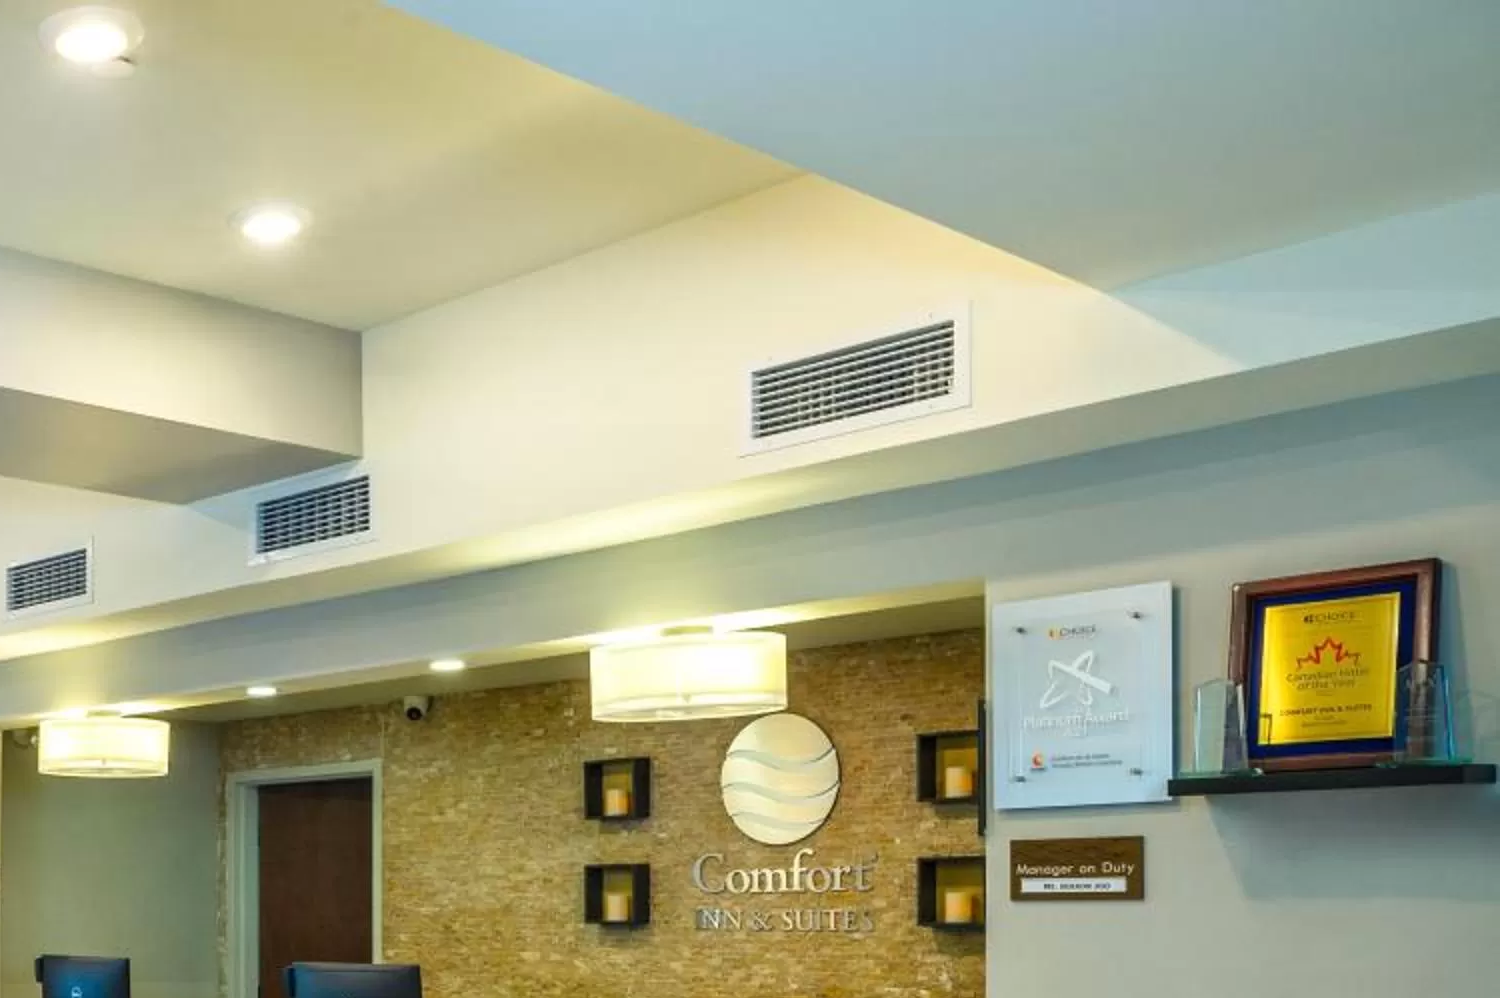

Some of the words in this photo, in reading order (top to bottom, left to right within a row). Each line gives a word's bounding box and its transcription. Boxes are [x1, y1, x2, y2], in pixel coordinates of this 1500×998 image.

[693, 848, 877, 894] Comfort
[1015, 863, 1075, 877] Manager
[1079, 864, 1097, 874] on
[1101, 860, 1136, 876] Duty
[697, 906, 742, 931] INN
[748, 907, 774, 932] &
[781, 905, 875, 933] SUITES
